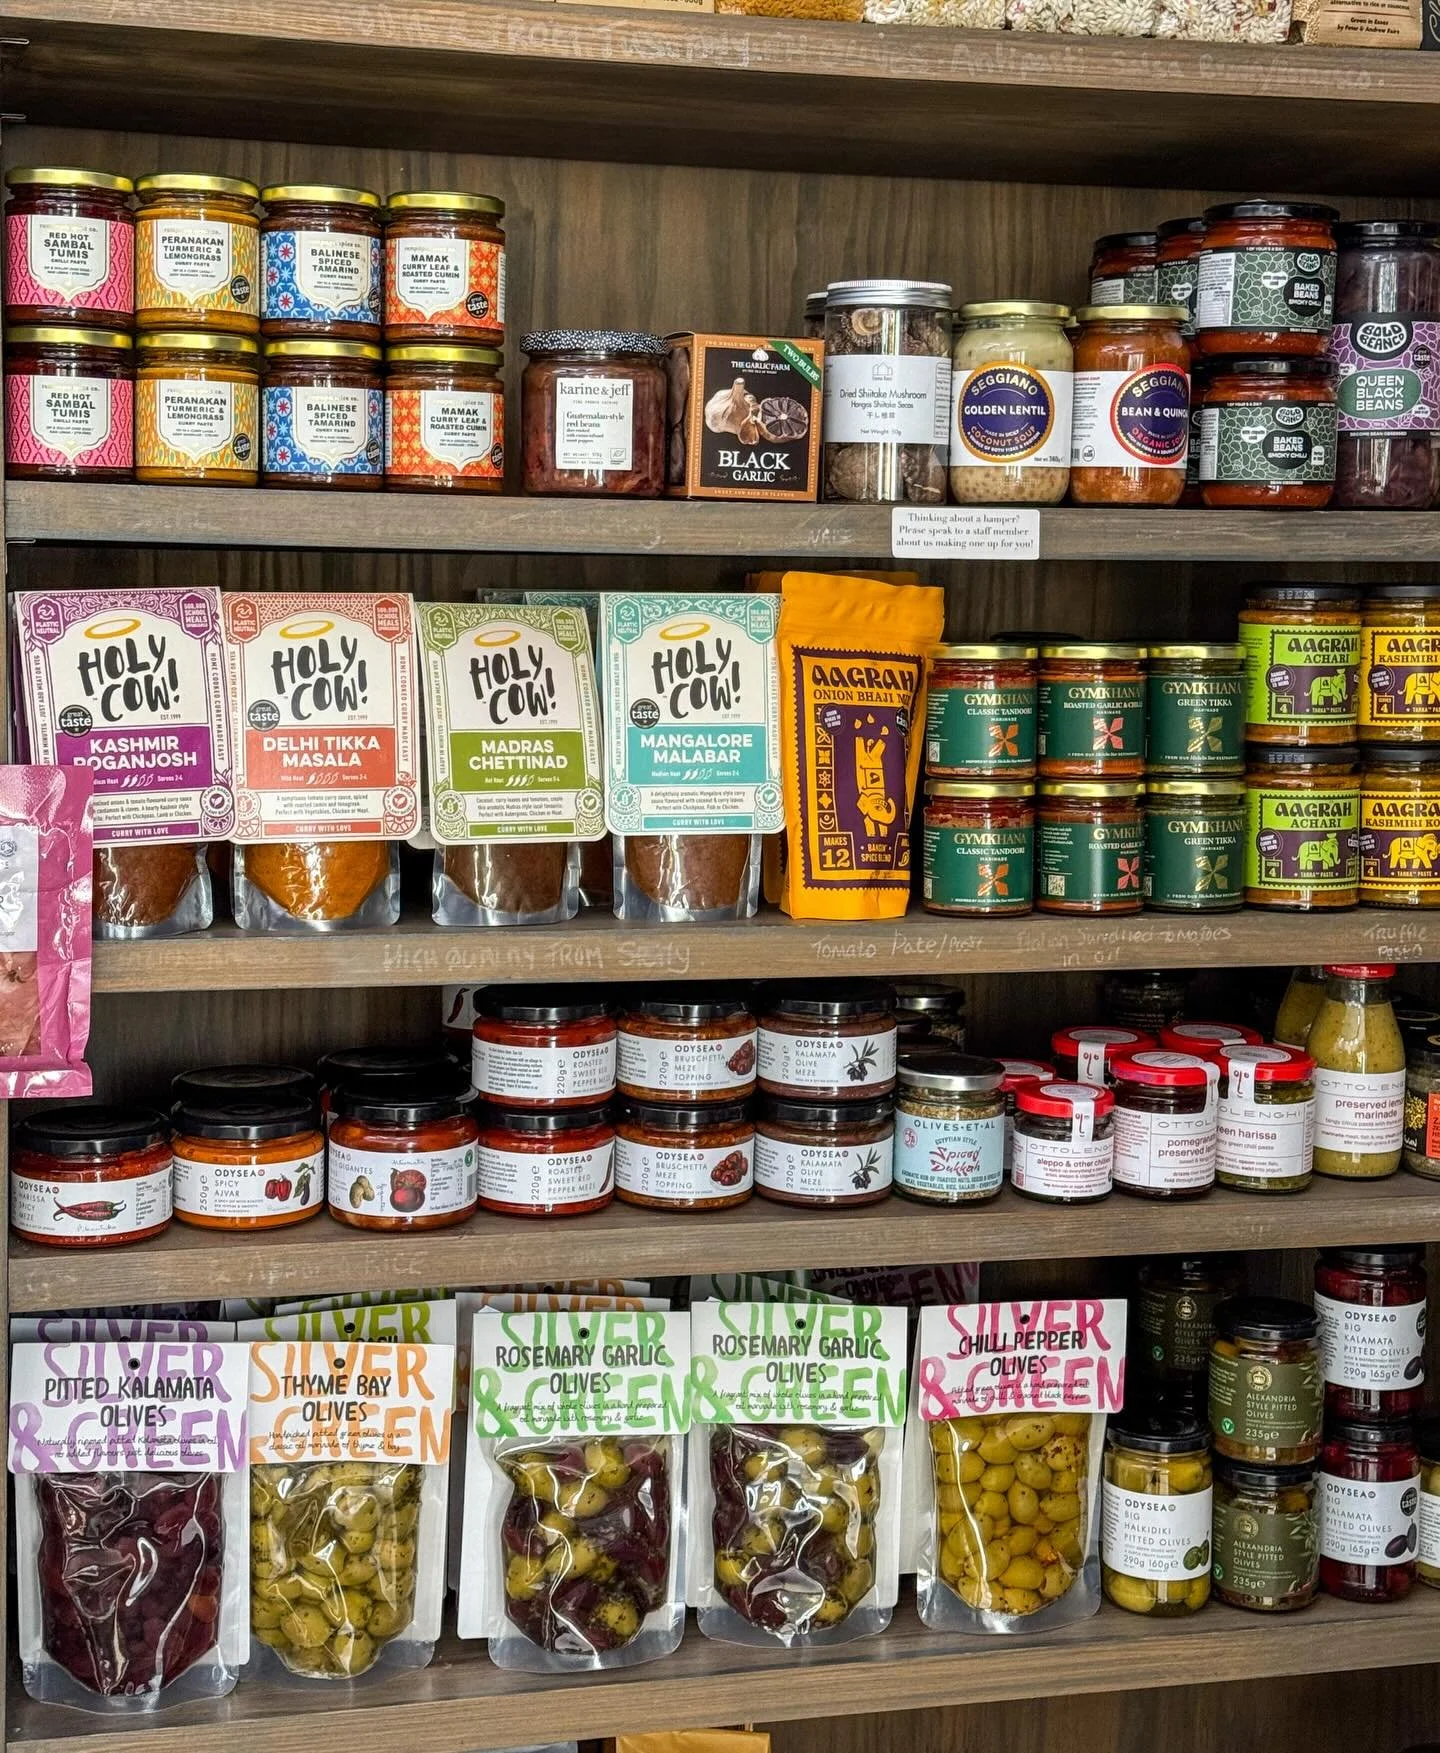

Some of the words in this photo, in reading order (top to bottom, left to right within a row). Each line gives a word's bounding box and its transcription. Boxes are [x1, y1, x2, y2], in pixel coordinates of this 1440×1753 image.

[49, 232, 67, 240] RED
[162, 236, 224, 246] PERANAKAN
[44, 239, 94, 250] SAMBAL
[164, 245, 212, 253] TURMERIC
[49, 249, 88, 259] TUMIS
[164, 252, 221, 262] LEMONGRASS
[311, 249, 360, 260] BALINESE
[319, 257, 352, 266] SPICED
[312, 264, 359, 275] TAMARIND
[1294, 283, 1319, 292] BAKED
[1294, 291, 1319, 300] BEANS
[1362, 325, 1402, 337] BOLD
[783, 344, 801, 361] TWO
[798, 358, 819, 381] BULBS
[971, 374, 1038, 396] SEGGIANO
[1356, 375, 1404, 386] QUEEN
[560, 383, 599, 396] karine
[601, 387, 608, 395] &
[610, 383, 631, 397] jeff
[840, 389, 857, 399] Dried
[859, 390, 887, 399] Shiitake
[889, 390, 926, 399] Mushroom
[1356, 387, 1403, 398] BLACK
[965, 405, 1006, 415] GOLDEN
[1010, 406, 1046, 415] LENTIL
[1356, 399, 1403, 410] BEANS
[442, 407, 479, 416] MAMAK
[566, 412, 624, 422] Guatemalan-style
[1122, 407, 1151, 416] BEAN
[1155, 407, 1160, 416] &
[431, 416, 458, 424] CURRY
[566, 420, 578, 428] red
[970, 426, 1012, 446] COCONUT
[1015, 426, 1036, 442] SOUP
[1273, 437, 1304, 445] BAKED
[1273, 444, 1303, 452] BEANS
[718, 451, 790, 470] BLACK
[733, 471, 776, 482] GARLIC
[908, 513, 947, 523] Thinking
[950, 514, 973, 522] about
[983, 514, 1020, 525] hamper?
[928, 526, 951, 535] speak
[973, 527, 991, 535] staff
[896, 538, 920, 546] about
[936, 539, 967, 549] making
[988, 541, 998, 549] up
[1001, 539, 1012, 548] for
[1015, 540, 1033, 550] you!
[1288, 638, 1357, 652] AAGRAH
[1304, 652, 1350, 664] ACHARI
[1379, 653, 1438, 664] KASHMIRI
[77, 634, 165, 696] HOLY
[271, 636, 357, 695] HOLY
[652, 638, 732, 694] HOLY
[469, 645, 543, 700] HOLY
[812, 665, 914, 691] AAGRAH
[101, 658, 180, 722] COW!
[291, 660, 367, 720] COW!
[670, 661, 741, 719] COW!
[1162, 681, 1241, 694] GYMKHANA
[489, 668, 556, 725] COW!
[813, 689, 853, 701] ONION
[858, 690, 893, 703] BHAJI
[249, 712, 280, 723] taste
[633, 710, 658, 719] taste
[61, 718, 92, 728] taste
[90, 736, 179, 753] KASHMIR
[264, 737, 319, 751] DELHI
[324, 736, 380, 750] TIKKA
[482, 740, 554, 753] MADRAS
[641, 734, 752, 748] MANGALORE
[282, 753, 361, 767] MASALA
[469, 755, 568, 769] CHETTINAD
[654, 750, 741, 763] MALABAR
[1275, 802, 1352, 817] AAGRAH
[1291, 817, 1341, 828] ACHARI
[135, 828, 152, 836] WITH
[154, 827, 169, 835] LOVE
[824, 837, 848, 846] MAKES
[954, 833, 1026, 845] GYMKHANA
[822, 849, 850, 868] 12
[812, 940, 876, 959] Tomato
[796, 1040, 837, 1048] ODYSEA
[1335, 1099, 1386, 1109] preserved
[935, 1137, 962, 1145] EGYPTIAN
[962, 1137, 977, 1145] STYLE
[1239, 1131, 1277, 1141] harissa
[929, 1146, 982, 1162] Spiced
[548, 1156, 587, 1166] ODYSEA
[1037, 1158, 1063, 1167] aleppo
[1073, 1159, 1093, 1168] other
[215, 1168, 256, 1177] ODYSEA
[930, 1159, 981, 1177] Dukkah
[214, 1190, 240, 1198] AJVAR
[1345, 1311, 1389, 1322] ODYSEA
[713, 1335, 811, 1356] ROSEMARY
[819, 1337, 882, 1359] GARLIC
[959, 1332, 1007, 1355] CHILLI
[1014, 1330, 1083, 1350] PEPPER
[1345, 1337, 1393, 1345] KALAMATA
[496, 1345, 595, 1367] ROSEMARY
[603, 1345, 666, 1366] GARLIC
[990, 1356, 1048, 1376] OLIVES
[766, 1362, 827, 1383] OLIVES
[45, 1377, 110, 1400] PITTED
[118, 1376, 214, 1400] KALAMATA
[281, 1374, 348, 1397] THYME
[357, 1374, 391, 1397] BAY
[551, 1372, 611, 1394] OLIVES
[920, 1356, 960, 1421] &
[967, 1357, 1124, 1412] GREEN
[1246, 1393, 1296, 1402] ALEXANDRIA
[101, 1405, 167, 1428] OLIVES
[302, 1401, 368, 1422] OLIVES
[10, 1402, 60, 1473] &
[68, 1409, 247, 1470] GREEN
[1125, 1499, 1168, 1511] ODYSEA
